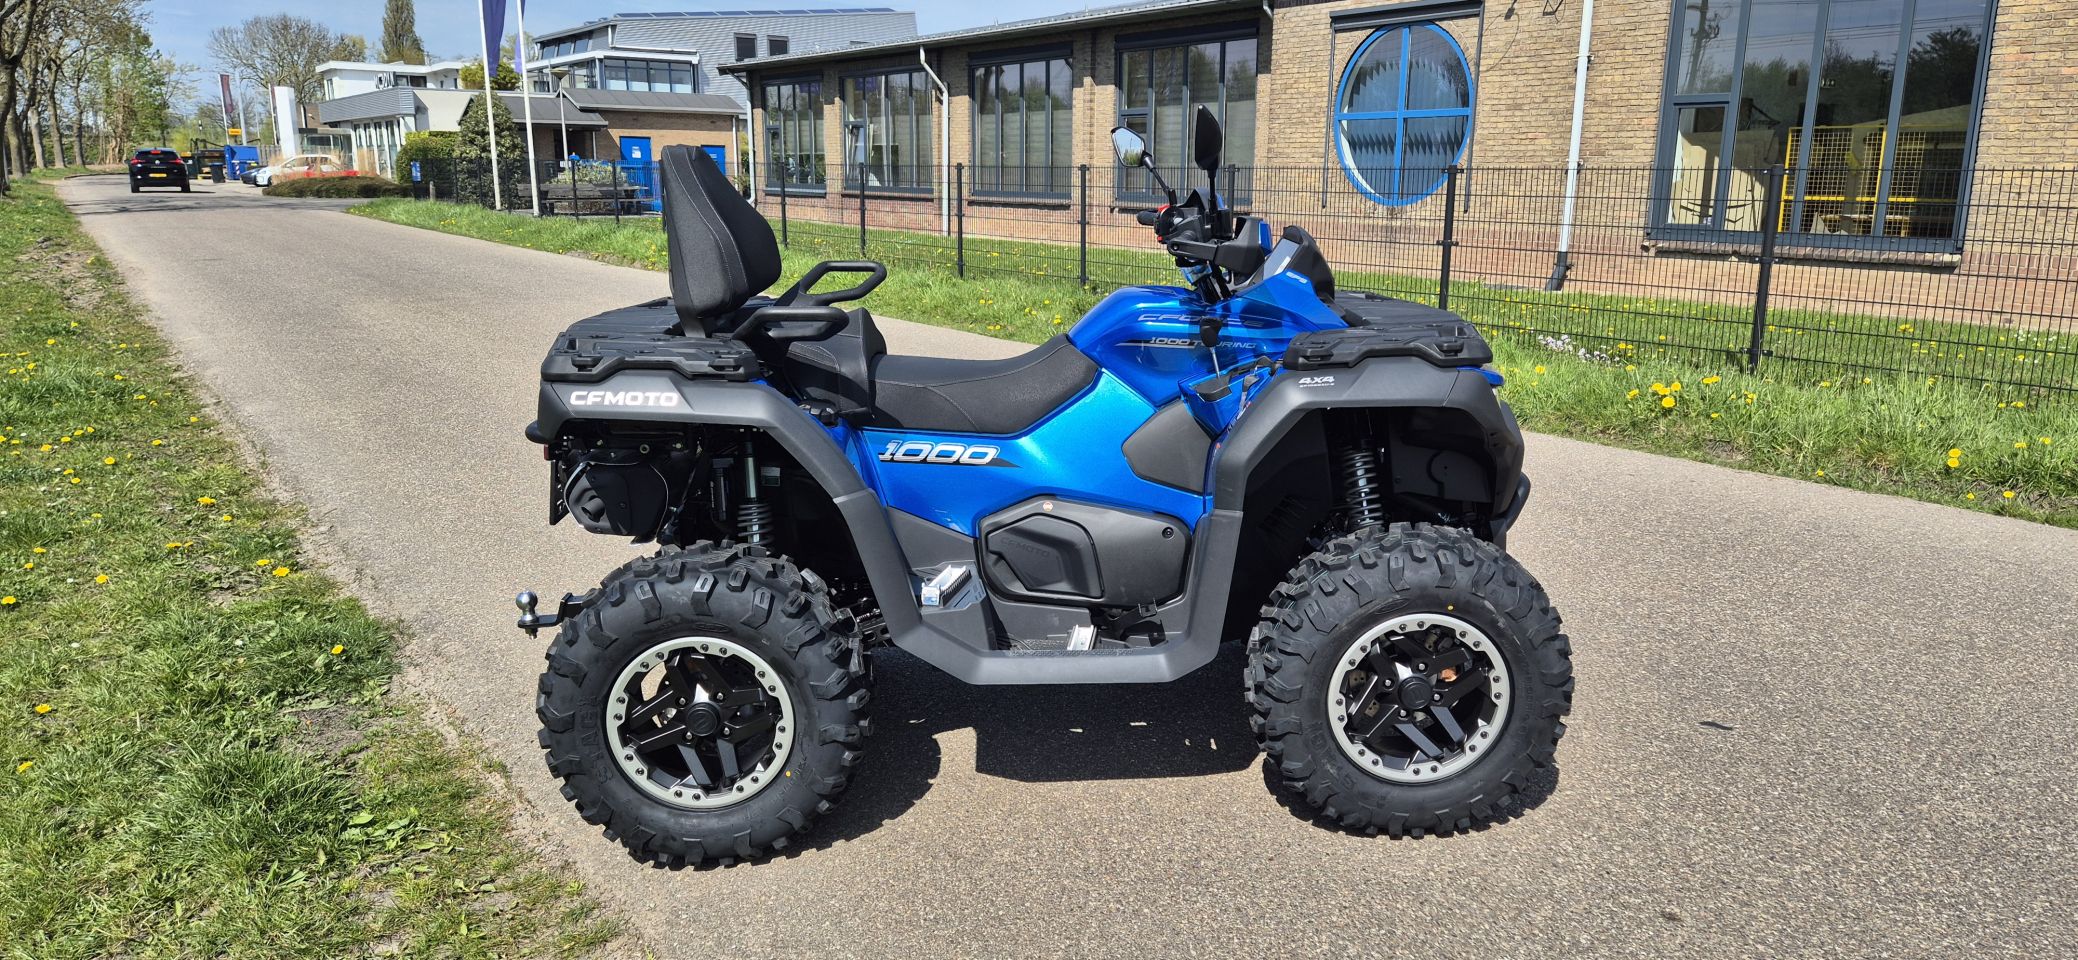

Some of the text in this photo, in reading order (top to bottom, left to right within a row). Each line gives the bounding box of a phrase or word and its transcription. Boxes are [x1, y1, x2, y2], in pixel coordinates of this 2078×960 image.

[1137, 313, 1264, 327] CFOCE
[1149, 336, 1191, 346] 1000
[569, 390, 680, 407] CFMOTO
[878, 439, 1000, 465] 1000
